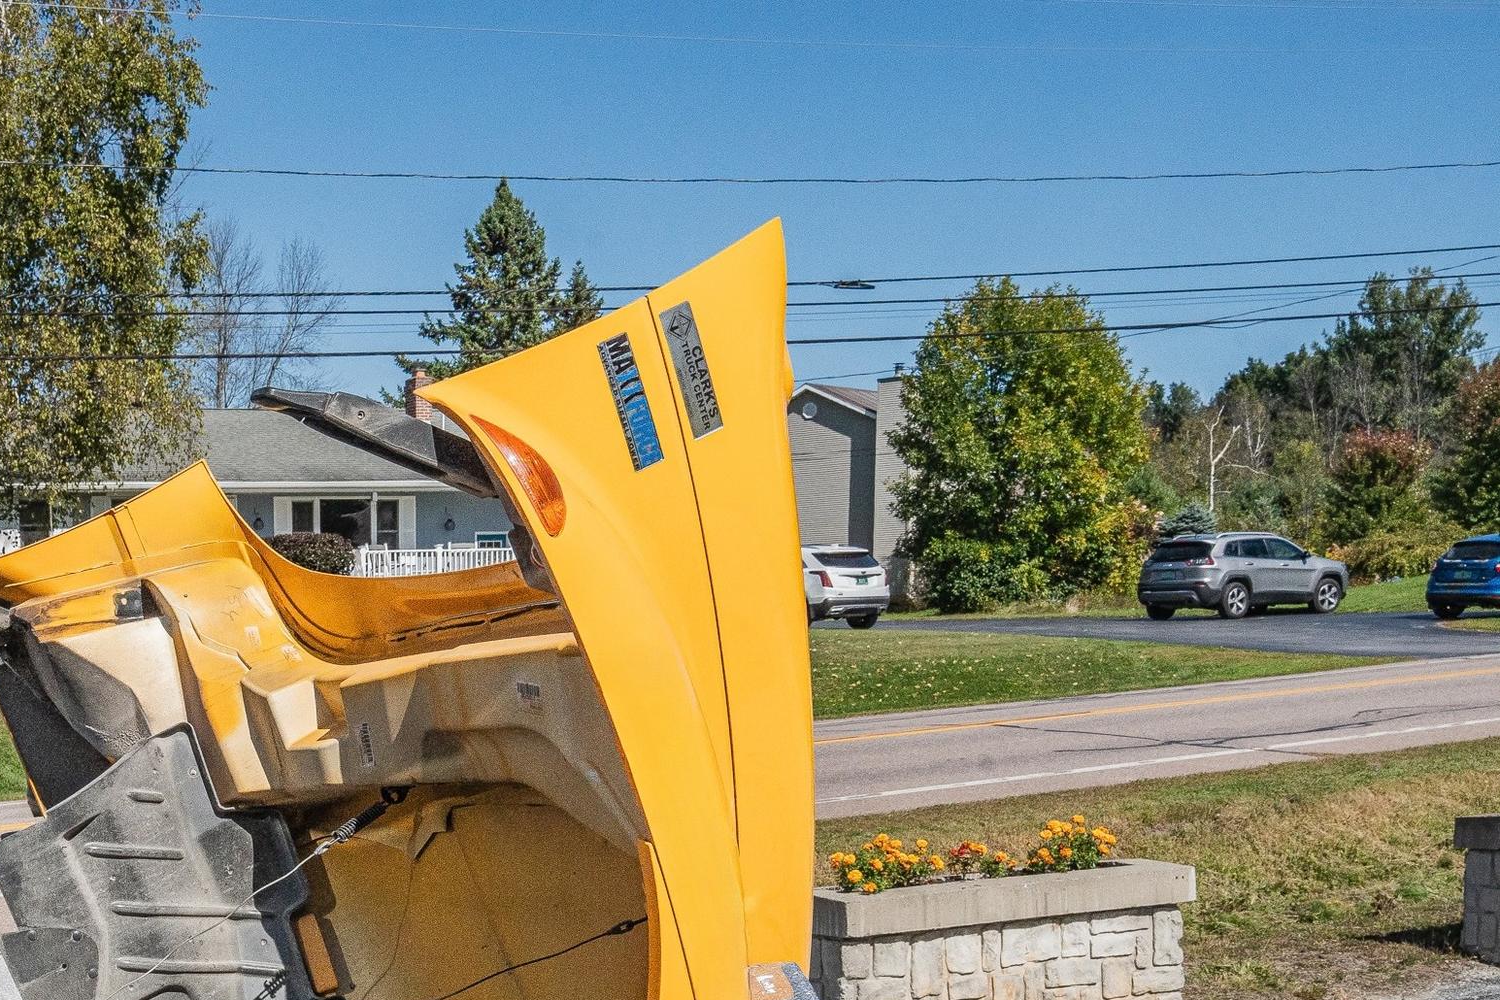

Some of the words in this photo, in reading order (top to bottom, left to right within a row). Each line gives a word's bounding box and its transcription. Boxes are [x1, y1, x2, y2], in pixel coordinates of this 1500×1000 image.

[597, 345, 619, 398] ADVANCED
[615, 398, 630, 436] DIESEL
[626, 435, 641, 471] POWER
[681, 341, 699, 382] TRUCK
[693, 384, 711, 430] CENTER
[692, 345, 719, 419] CLARK'S
